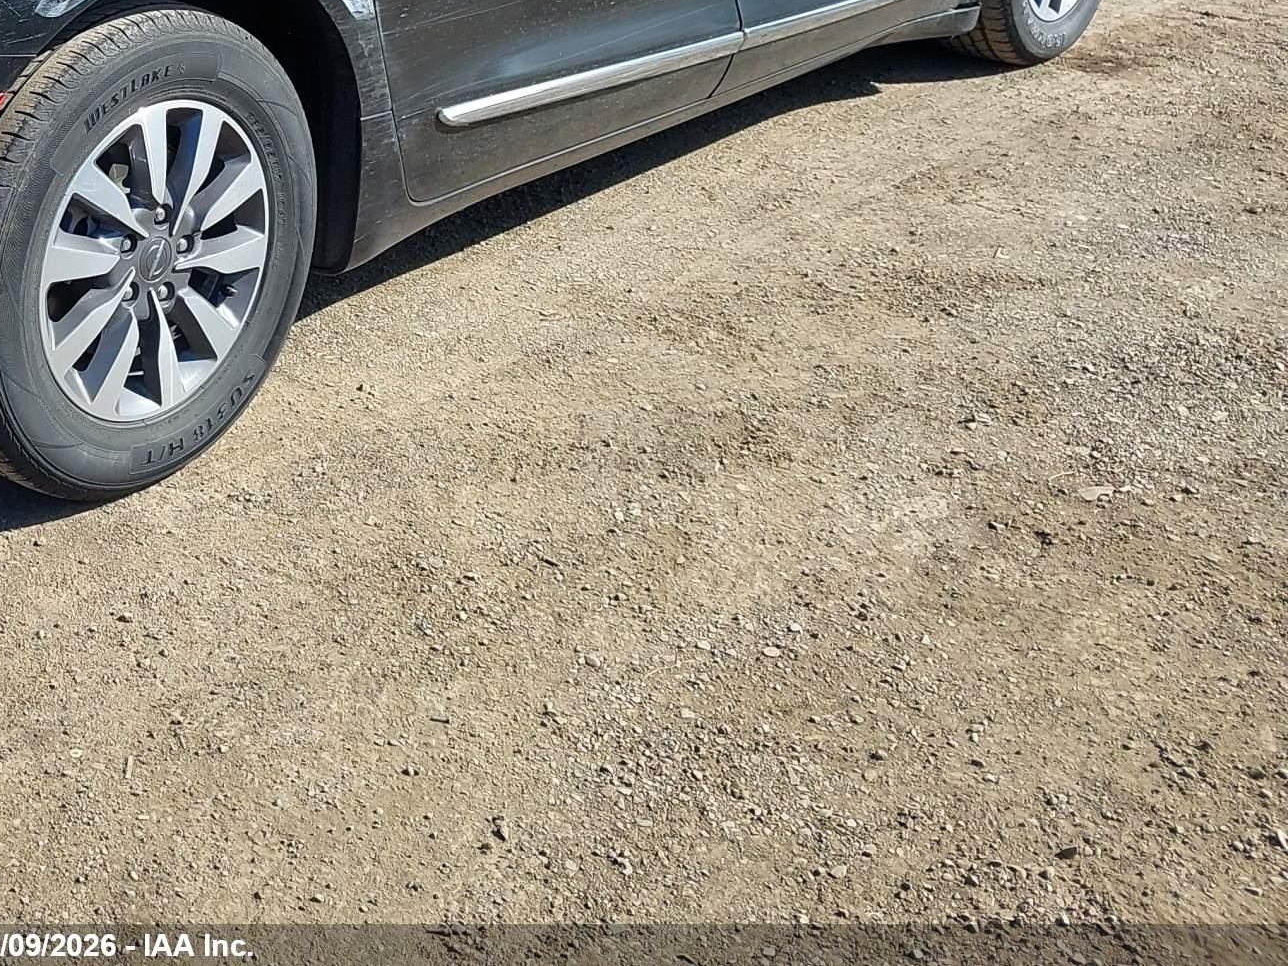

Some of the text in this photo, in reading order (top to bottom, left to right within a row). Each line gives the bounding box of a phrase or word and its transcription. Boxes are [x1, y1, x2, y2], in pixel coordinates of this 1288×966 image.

[83, 64, 174, 134] WESTLAKE
[141, 370, 255, 466] SU318 H/T
